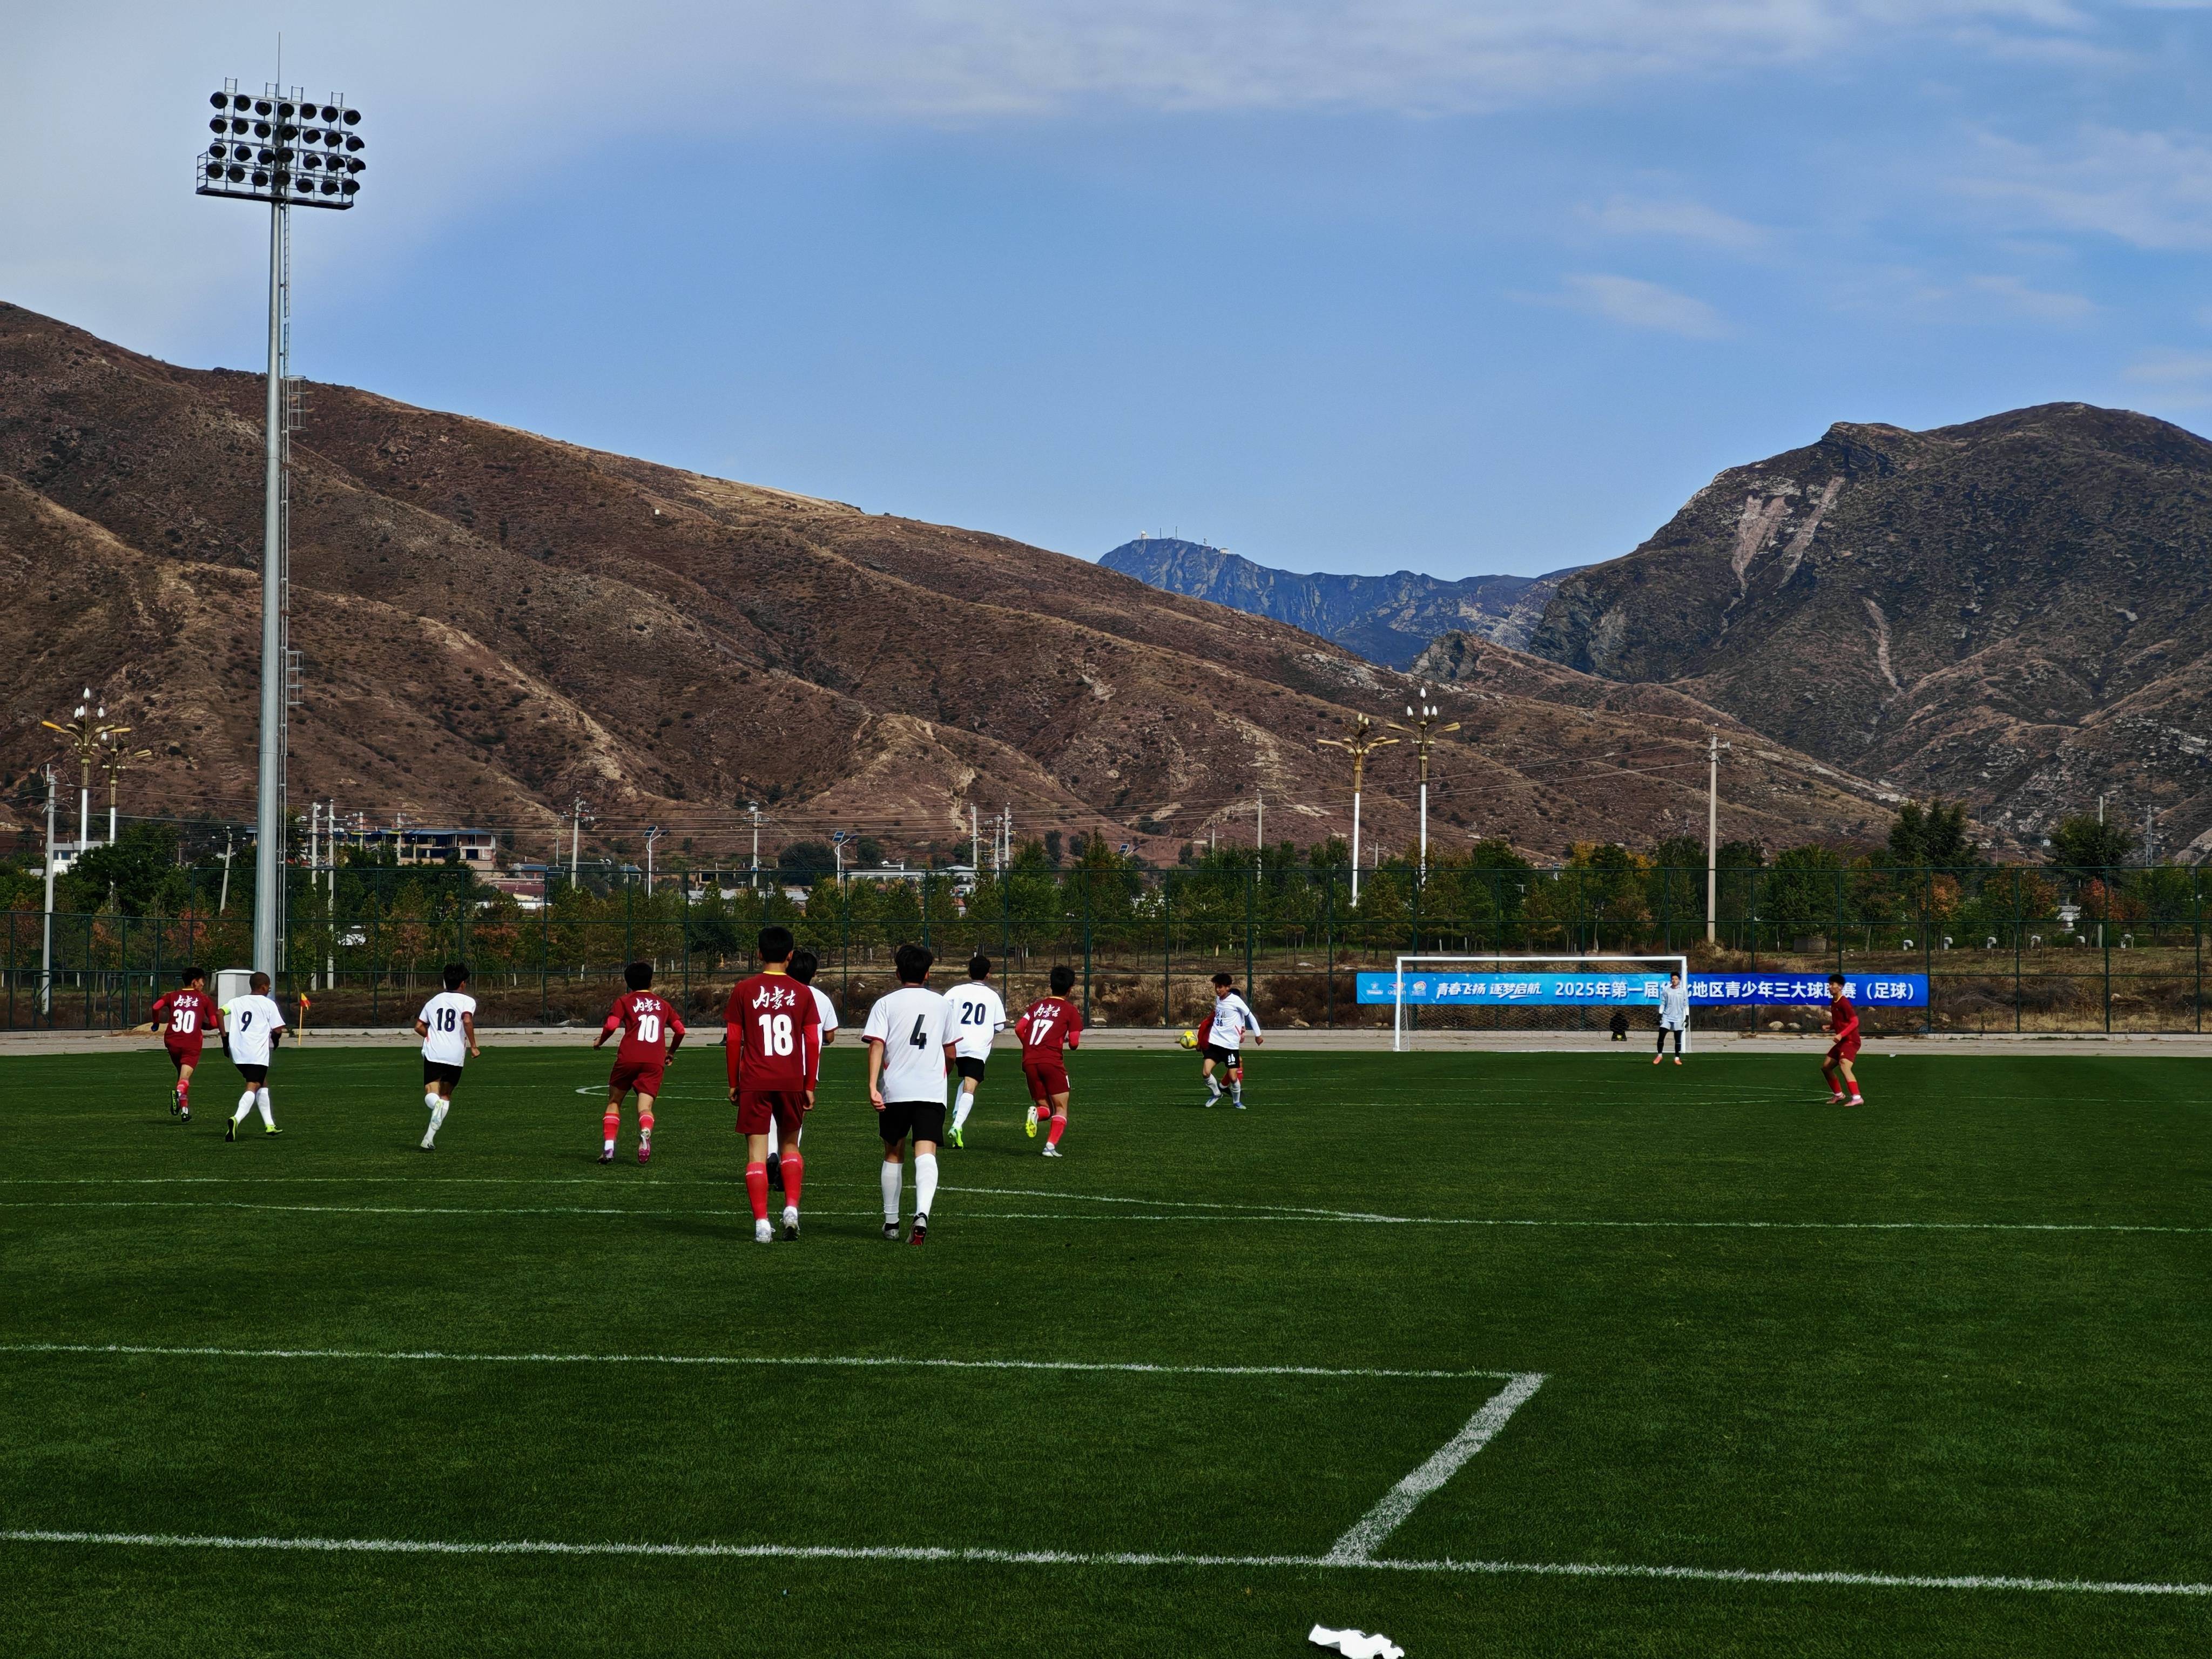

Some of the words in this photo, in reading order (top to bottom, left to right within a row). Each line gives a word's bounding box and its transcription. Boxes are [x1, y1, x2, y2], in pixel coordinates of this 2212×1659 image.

[752, 986, 796, 1010] 内蒙古
[1436, 982, 1486, 999] 青春飞扬
[1489, 982, 1543, 999] 逐梦启航
[633, 997, 661, 1013] 内蒙古
[961, 1001, 986, 1025] 20
[172, 1009, 195, 1034] 30
[241, 1011, 252, 1032] 9
[436, 1008, 456, 1032] 18
[637, 1014, 659, 1043] 10
[909, 1014, 927, 1050] 4
[1216, 1019, 1223, 1027] 36
[758, 1014, 793, 1056] 18
[1029, 1019, 1054, 1046] 17
